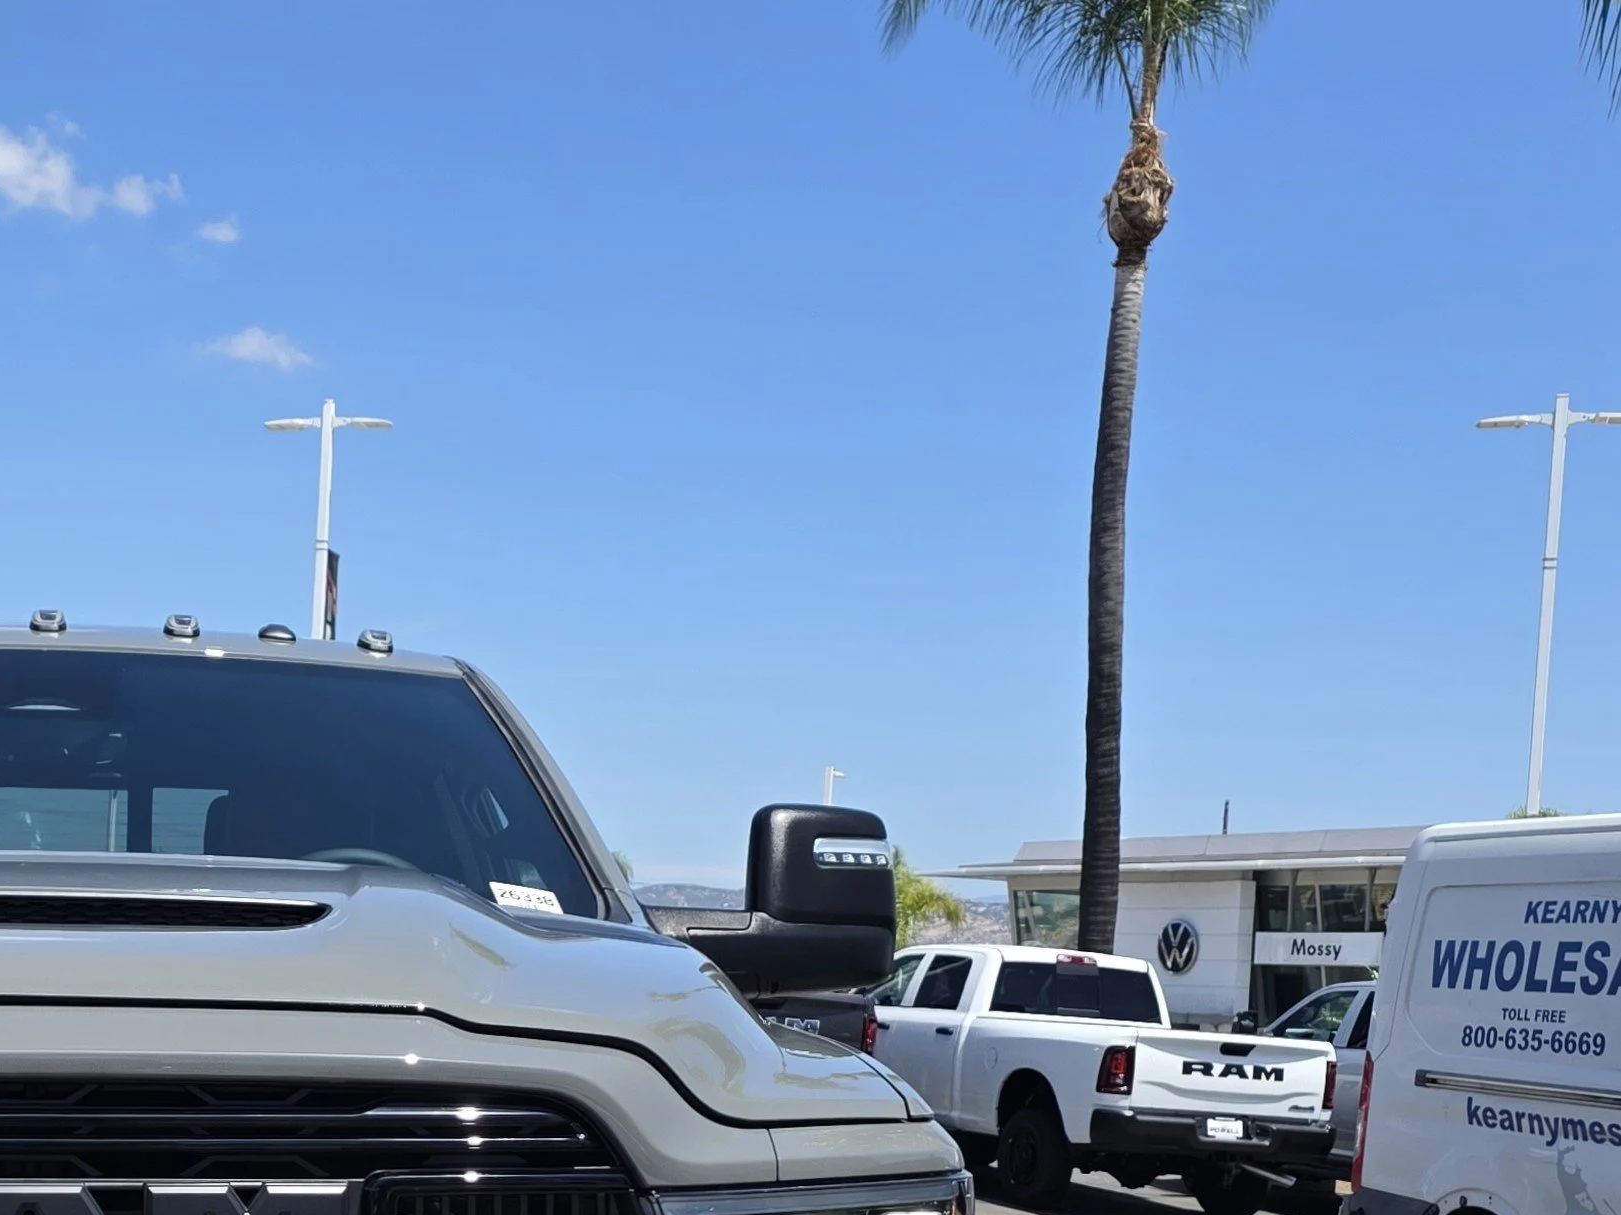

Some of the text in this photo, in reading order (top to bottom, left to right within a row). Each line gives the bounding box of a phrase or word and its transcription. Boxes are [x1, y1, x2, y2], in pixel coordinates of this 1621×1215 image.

[1524, 900, 1621, 924] KEARNY
[1291, 938, 1342, 960] Mossy
[1501, 1008, 1567, 1024] TOLL FREE
[1461, 1025, 1606, 1056] 800-635-6669
[1182, 1060, 1284, 1082] RAM
[1466, 1096, 1621, 1147] kearnymes
